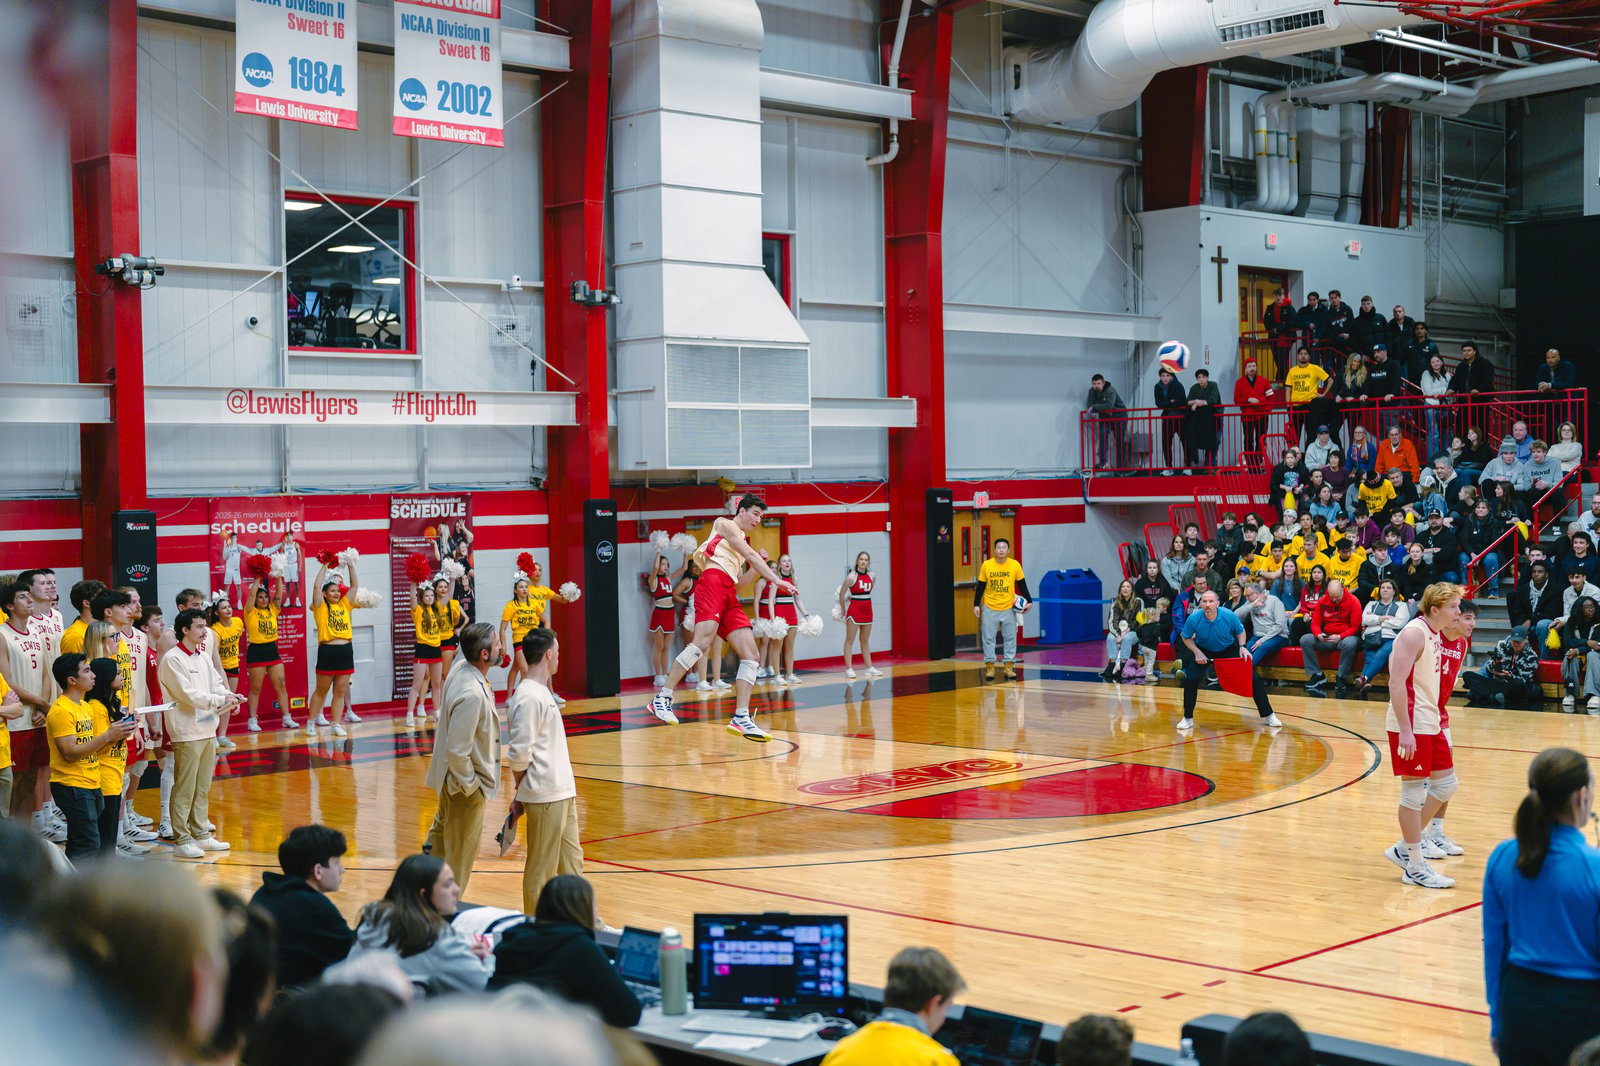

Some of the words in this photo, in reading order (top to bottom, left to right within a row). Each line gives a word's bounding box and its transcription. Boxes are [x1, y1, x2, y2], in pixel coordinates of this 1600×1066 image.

[288, 12, 328, 36] Sweet
[332, 22, 345, 39] 16
[401, 13, 433, 34] NCAA
[437, 19, 480, 41] Division
[439, 39, 476, 60] Sweet
[480, 46, 490, 62] 16
[245, 68, 272, 79] NCAA
[288, 56, 345, 97] 1984
[402, 93, 427, 103] NCAA
[437, 80, 492, 117] 2002
[255, 98, 285, 116] Lewis
[287, 104, 339, 126] University
[411, 121, 439, 138] Lewis
[440, 125, 486, 145] University
[226, 389, 358, 423] @LewisFlyers
[391, 392, 477, 423] #FlightOn
[1530, 469, 1551, 477] blond
[242, 511, 263, 519] men's
[264, 510, 299, 518] basketball
[391, 502, 467, 519] SCHEDULE
[210, 518, 303, 535] schedule
[126, 564, 151, 575] GATTO'S
[660, 581, 673, 594] LU
[859, 579, 872, 592] LU
[20, 640, 41, 653] LEWIS
[30, 653, 37, 670] 5
[1442, 659, 1450, 675] 4
